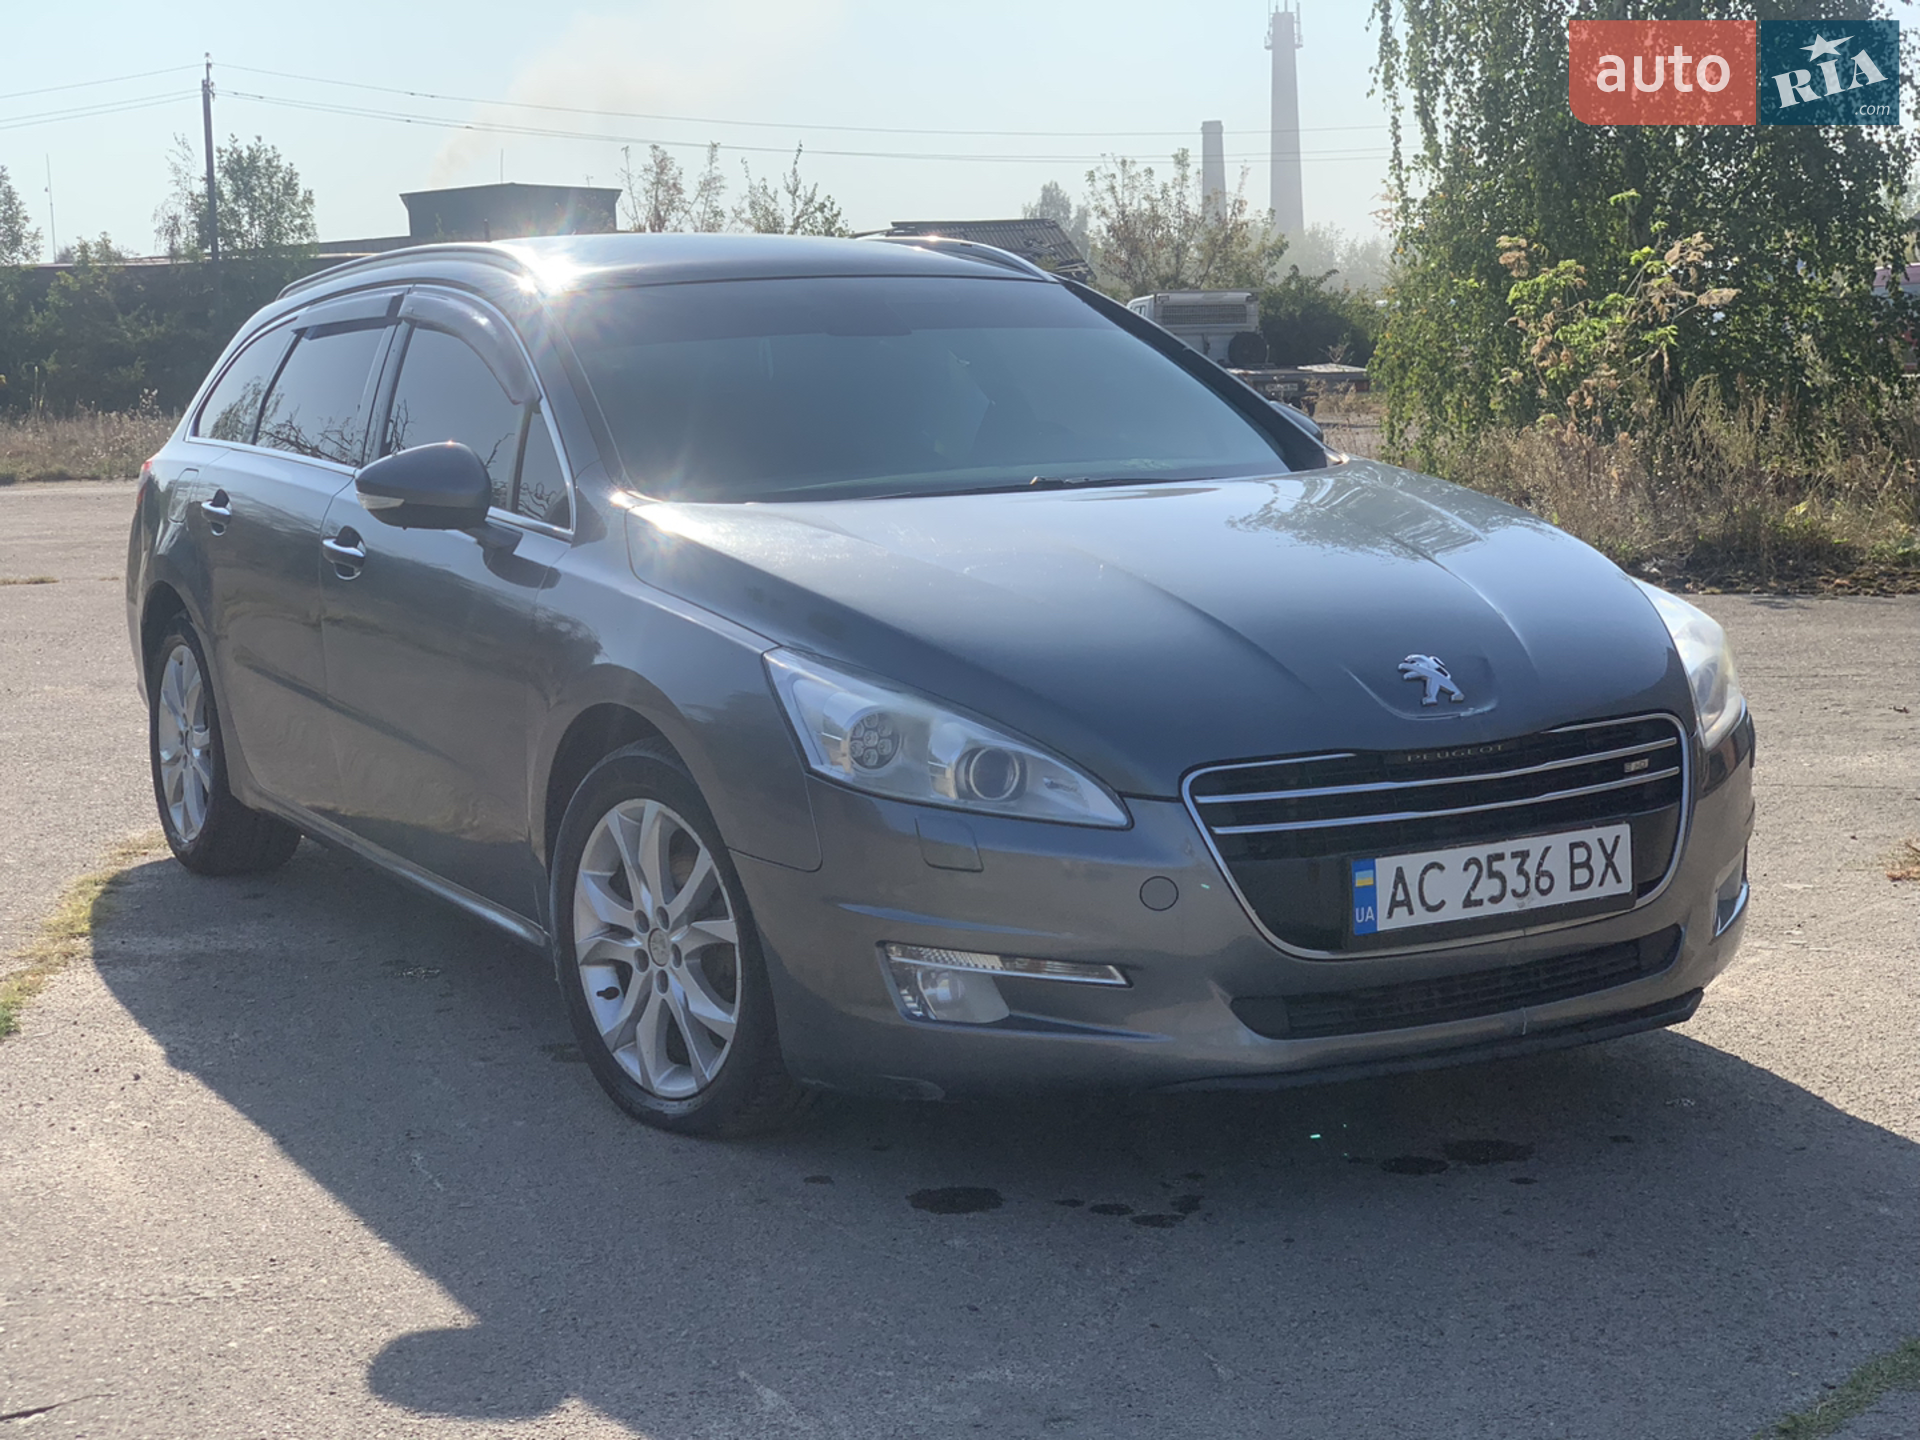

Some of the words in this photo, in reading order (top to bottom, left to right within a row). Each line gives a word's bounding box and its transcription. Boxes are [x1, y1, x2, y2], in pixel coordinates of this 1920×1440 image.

[1386, 860, 1446, 920] AC
[1462, 845, 1556, 909] 2536
[1568, 834, 1623, 892] BX
[1355, 906, 1375, 923] UA
